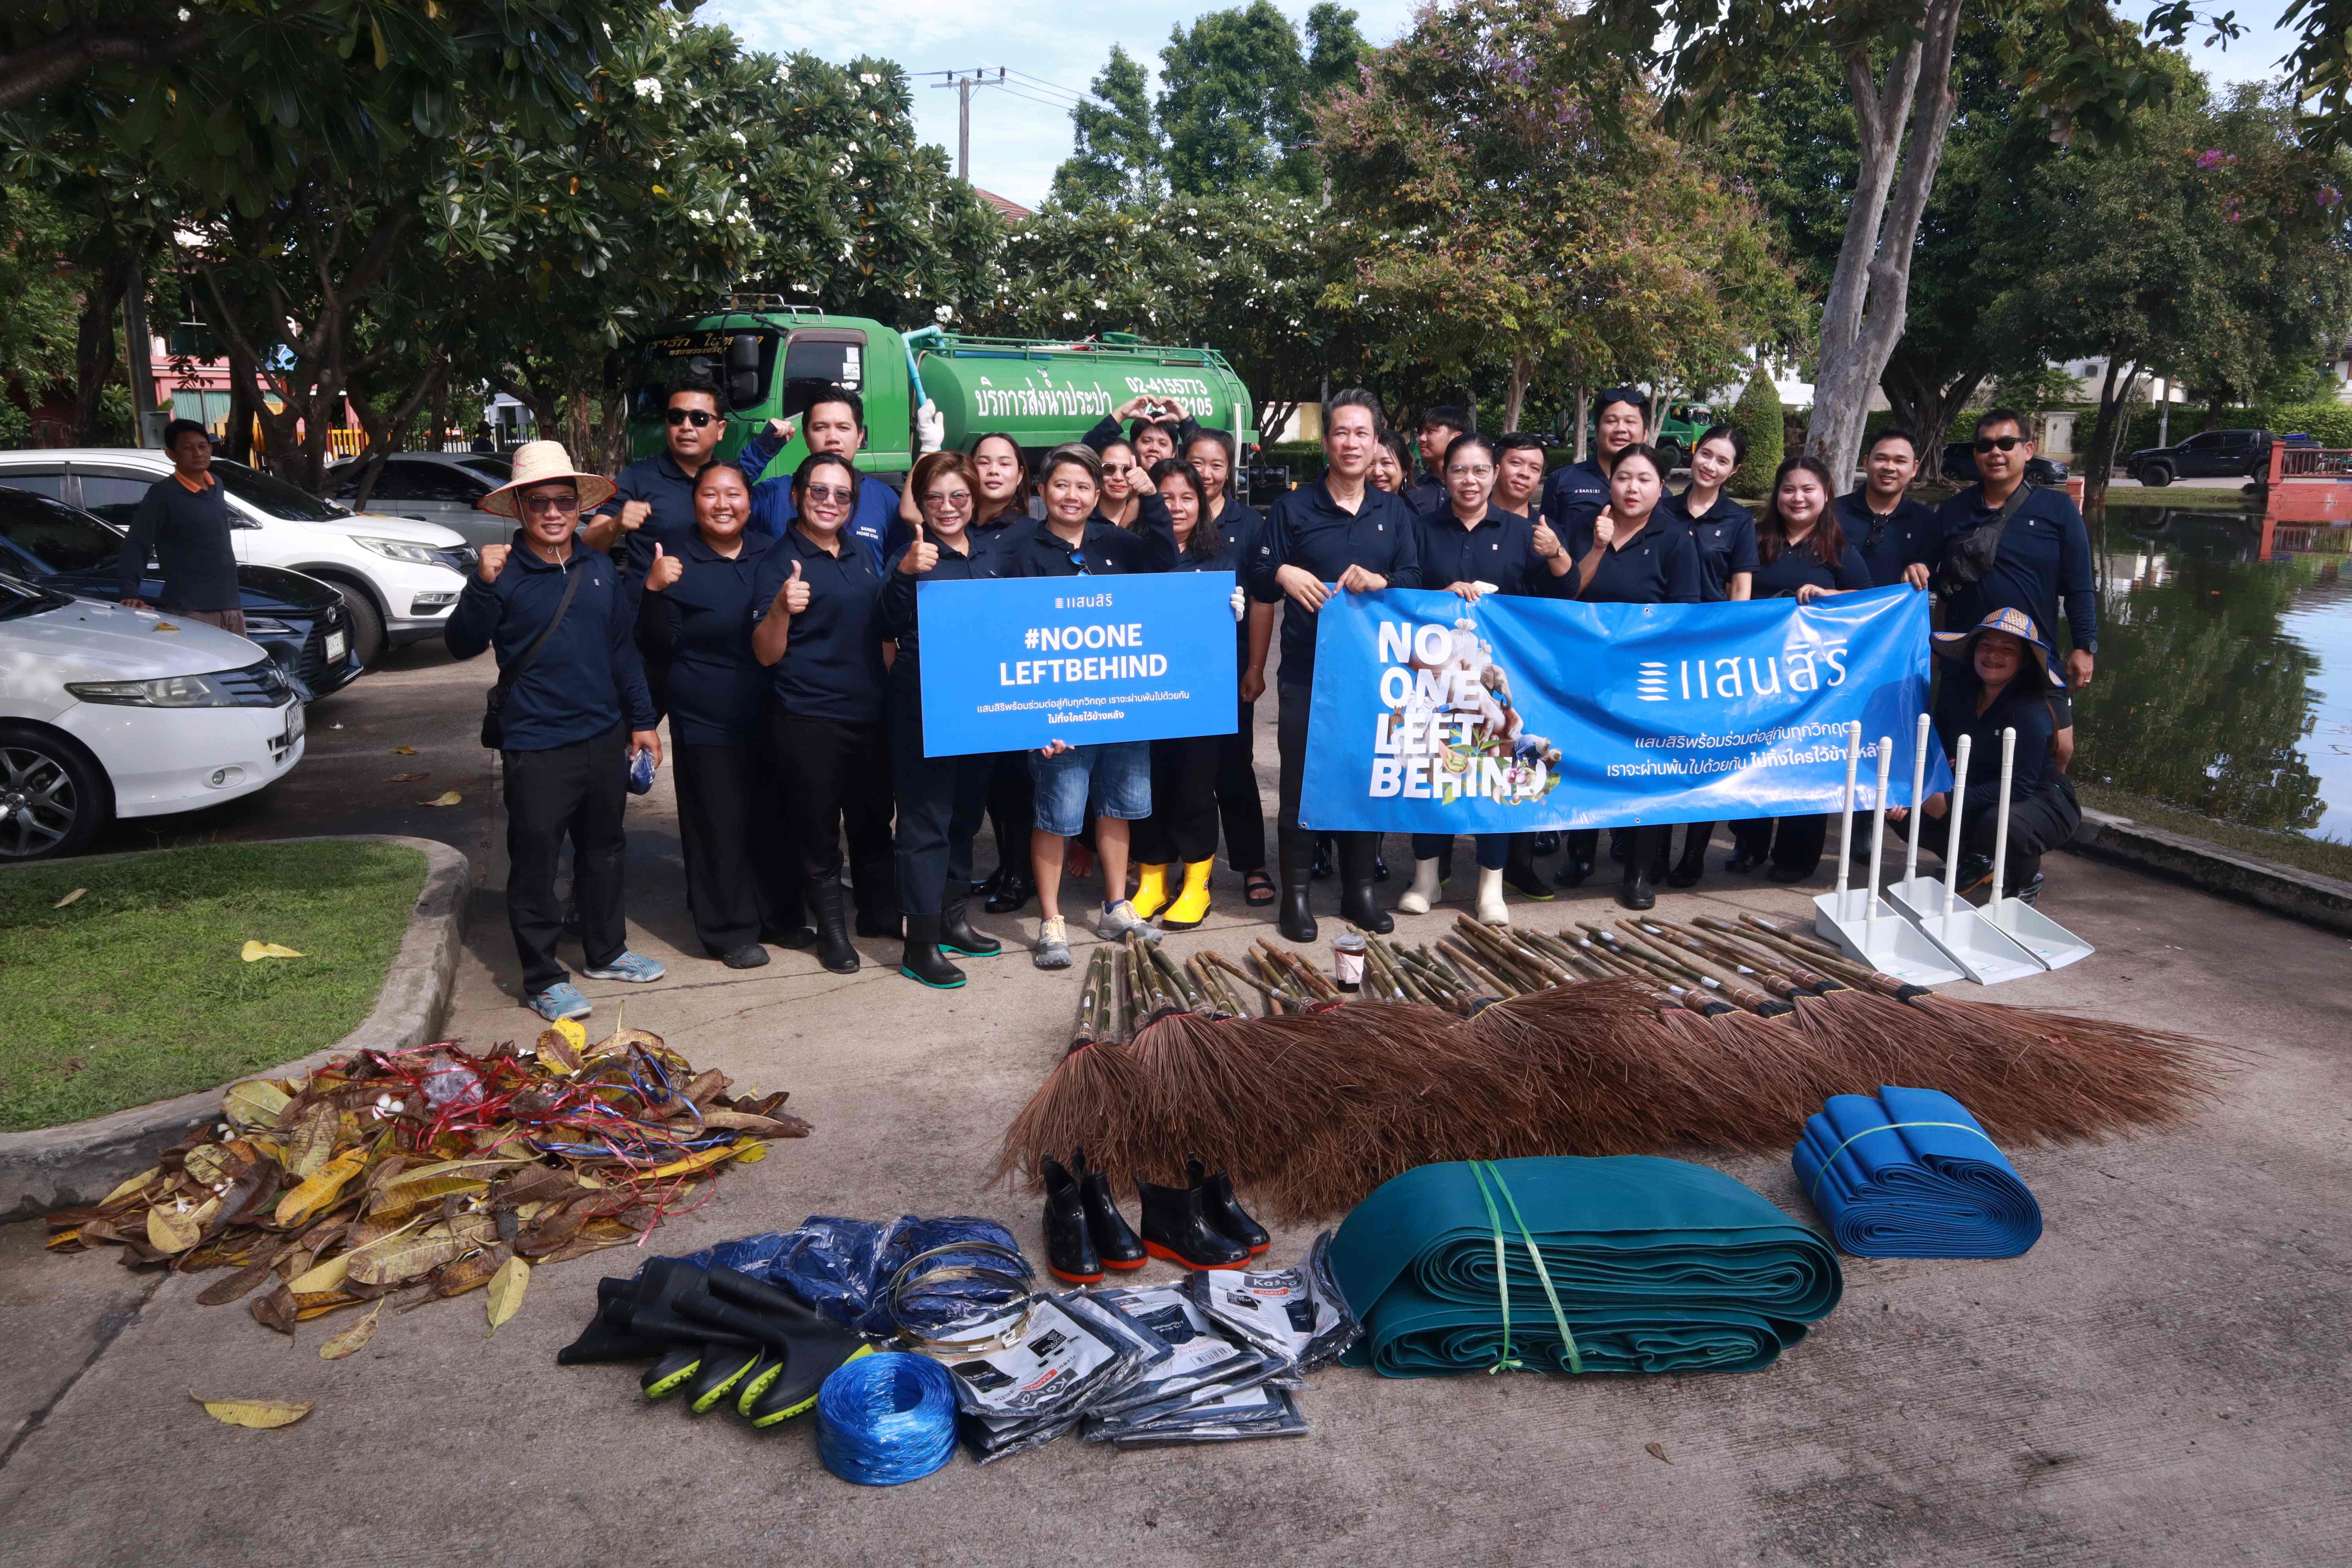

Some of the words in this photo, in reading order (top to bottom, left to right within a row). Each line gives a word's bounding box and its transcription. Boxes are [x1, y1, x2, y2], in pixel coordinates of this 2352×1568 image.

[975, 369, 1113, 416] บริการส่งน้ำประปา
[1125, 377, 1208, 395] 02-4155773
[1067, 593, 1112, 608] แสนสิริ
[1024, 624, 1143, 651] #NOONE
[1379, 621, 1452, 665] NO
[1000, 654, 1167, 686] LEFTBEHIND
[1681, 639, 1848, 700] แสนสิริ
[1109, 690, 1190, 704] เราจะผ่านพ้นไปด้วยกัน
[1380, 667, 1481, 710] ONE
[1047, 710, 1125, 724] ไม่ทิ้งใครไว้ข้างหลัง
[1374, 713, 1485, 754] LEFT
[1607, 756, 1747, 777] เราจะผ่านพ้นไปด้วยกัน
[1750, 742, 1879, 769] ไม่ทิ้งใครไว้ข้าหลั
[1369, 756, 1547, 799] BEHIND
